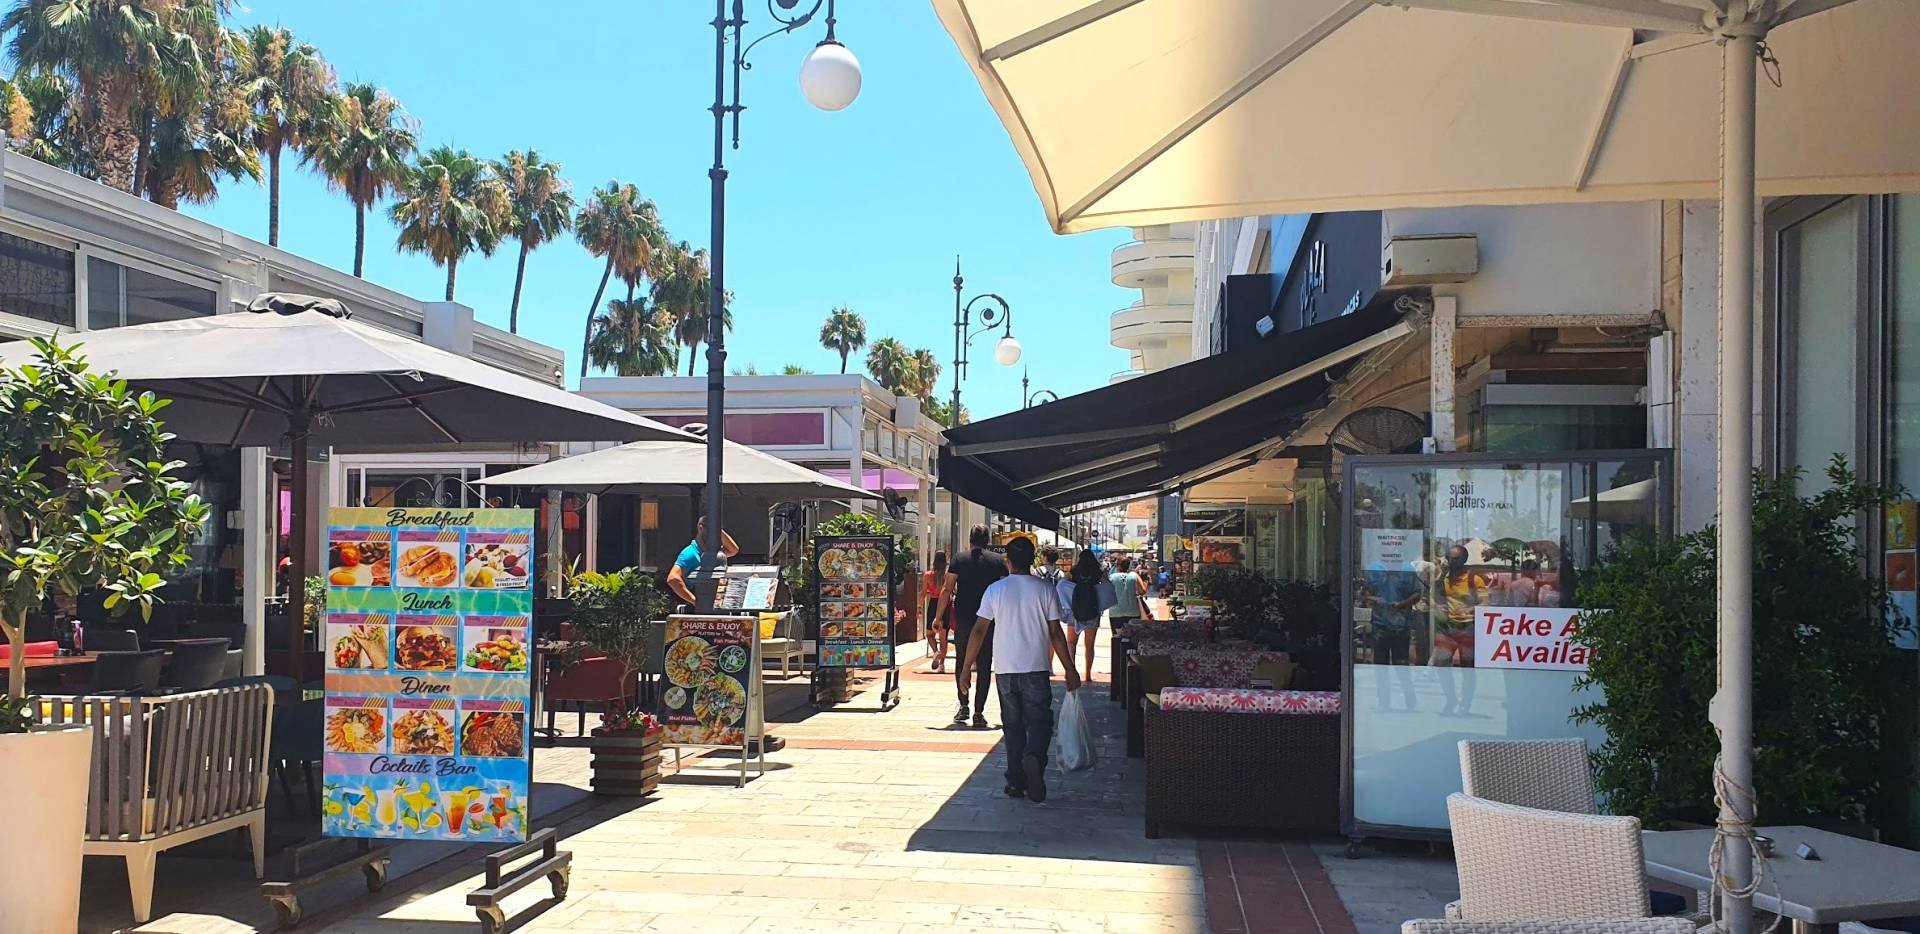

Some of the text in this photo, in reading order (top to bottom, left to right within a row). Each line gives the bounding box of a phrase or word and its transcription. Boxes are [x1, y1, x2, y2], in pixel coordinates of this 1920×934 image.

[1449, 480, 1475, 495] sushi
[1449, 494, 1486, 511] platters
[386, 508, 474, 530] Breakfast
[402, 592, 453, 611] Lunch
[682, 621, 707, 630] SHARE
[716, 623, 740, 631] ENJOY
[1483, 612, 1552, 637] Take
[400, 676, 451, 695] Diner
[369, 756, 477, 776] Coctails Bar
